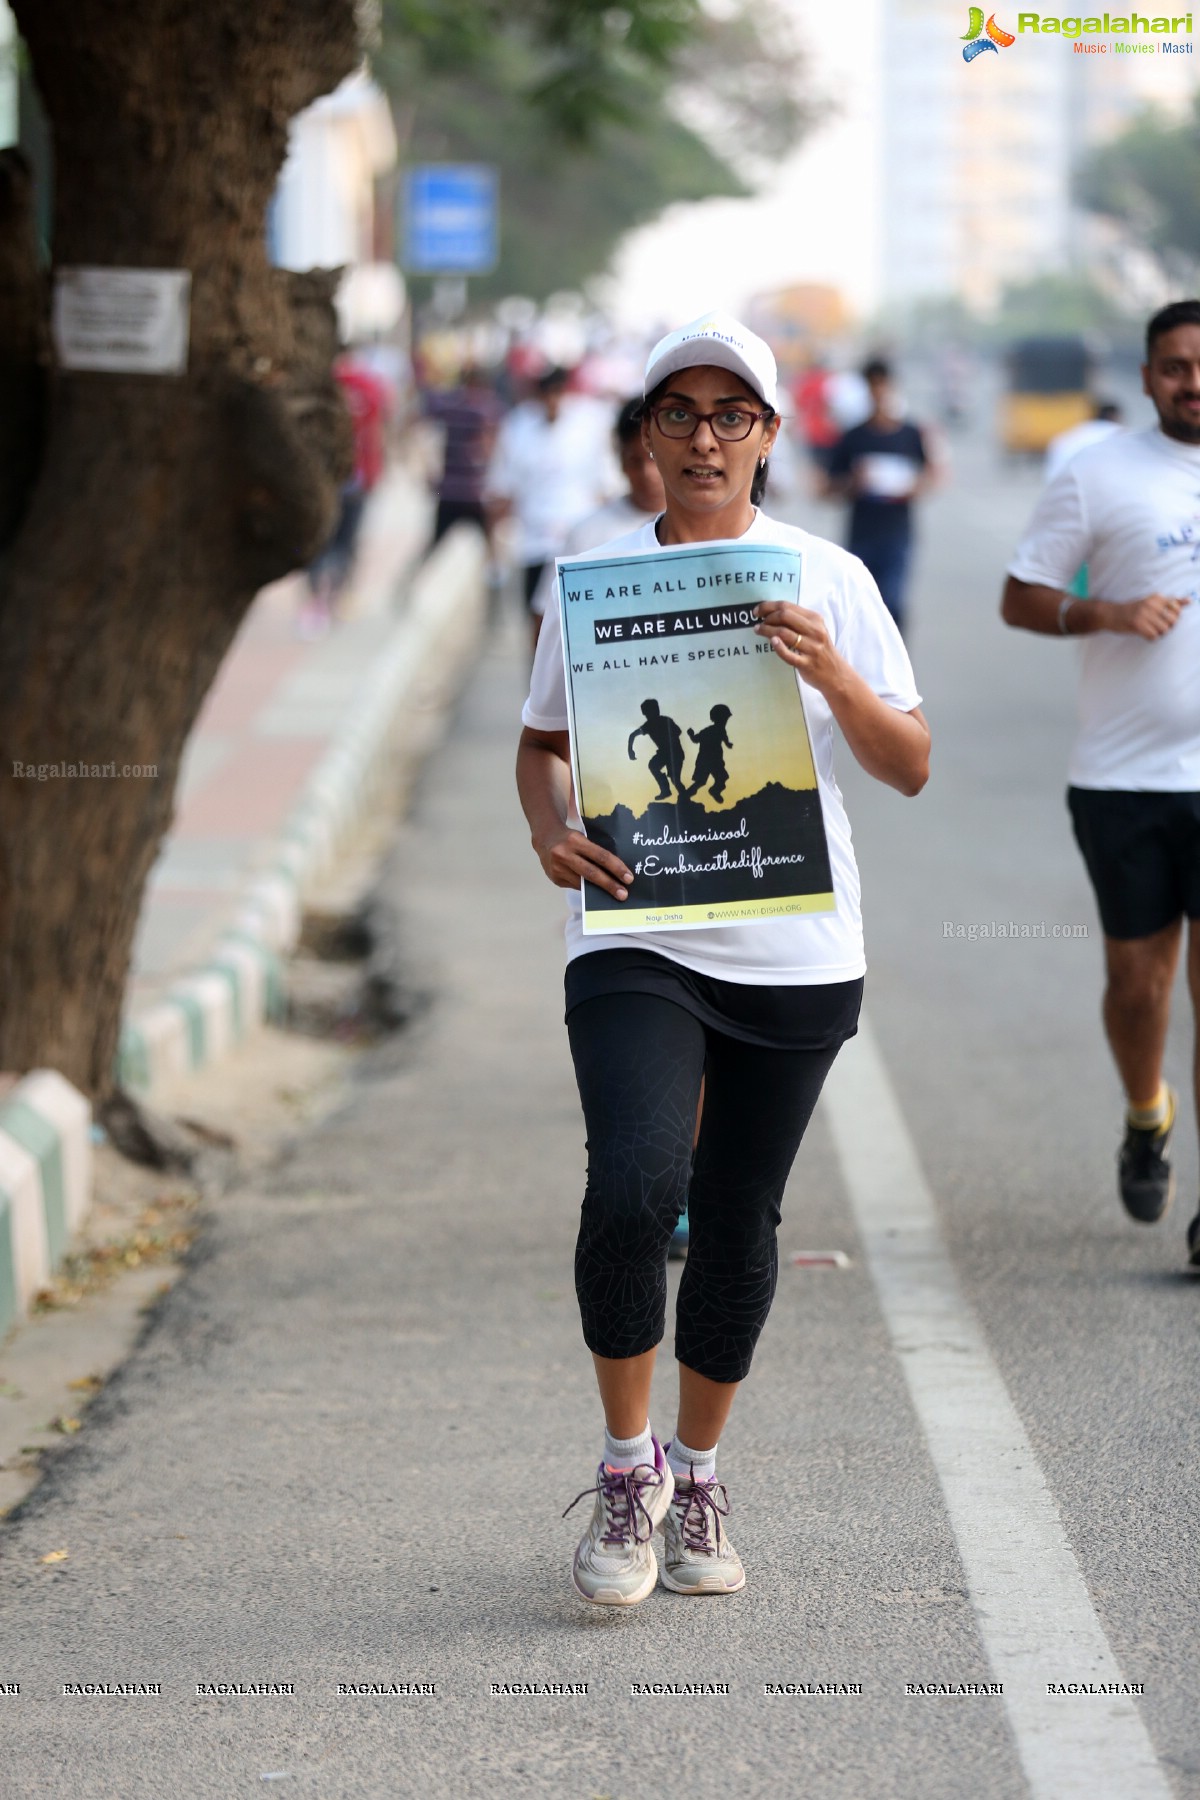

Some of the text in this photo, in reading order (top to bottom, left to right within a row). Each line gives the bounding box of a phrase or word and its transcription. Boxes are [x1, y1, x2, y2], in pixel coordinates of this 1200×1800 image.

[567, 572, 796, 602] WE ARE ALL DIFFERENT
[596, 610, 764, 639] WE ARE ALL UNIQU
[572, 662, 595, 673] WE
[603, 659, 631, 670] ALL
[639, 653, 680, 666] HAVE
[688, 646, 749, 661] SPECIAL
[632, 818, 749, 847] #inclusioniscool
[634, 847, 805, 879] #Embracethedifference
